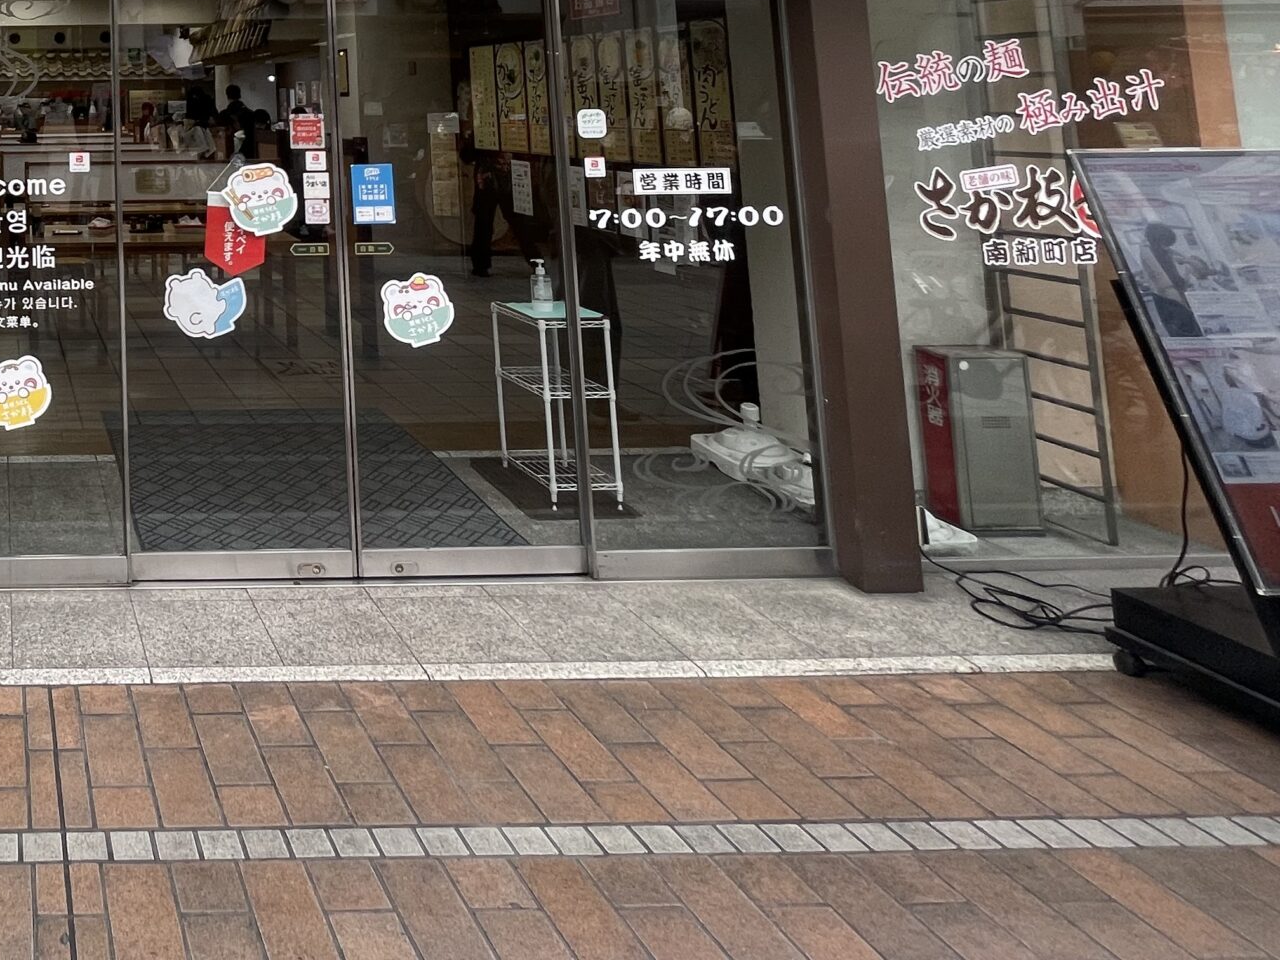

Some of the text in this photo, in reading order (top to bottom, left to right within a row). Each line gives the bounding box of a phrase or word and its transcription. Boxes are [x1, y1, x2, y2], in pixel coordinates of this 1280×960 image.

[877, 39, 1030, 103] 伝統の麺
[638, 172, 726, 191] 営業時間
[967, 171, 1014, 188] 老舗の味
[915, 166, 1094, 238] さか枝
[223, 221, 236, 266] 使えます。
[638, 239, 736, 262] 年中無休
[984, 240, 1097, 264] 南新町店
[23, 278, 95, 290] Available
[21, 296, 78, 310] 있습니다.
